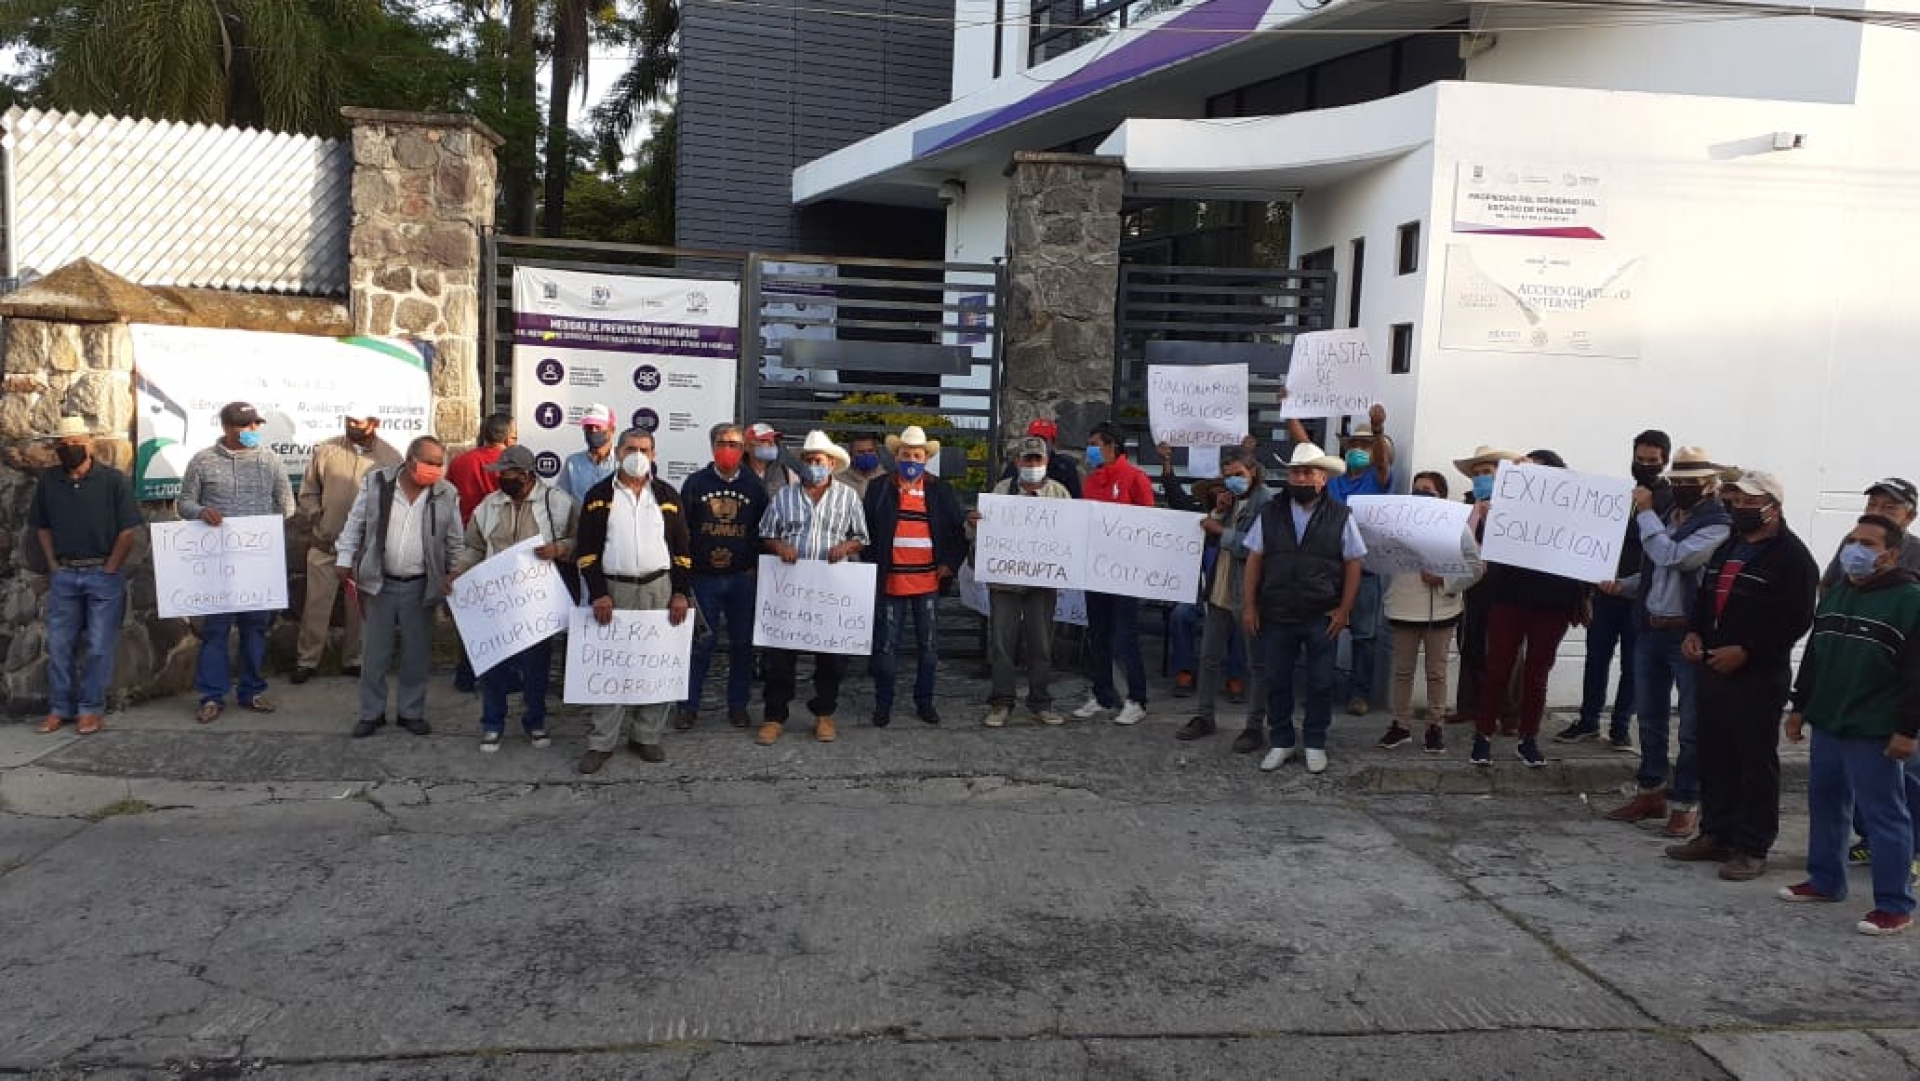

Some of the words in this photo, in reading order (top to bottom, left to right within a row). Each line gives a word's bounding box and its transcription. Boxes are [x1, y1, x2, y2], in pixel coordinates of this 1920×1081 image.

[1518, 283, 1566, 297] ACCESO
[1568, 286, 1631, 300] GRATO
[1500, 470, 1625, 522] EXIGIMOS
[1102, 515, 1200, 555] Vanessa
[1493, 510, 1611, 563] SOLUCION
[986, 557, 1069, 581] CORRUPTA
[581, 643, 684, 669] DIRECTORA
